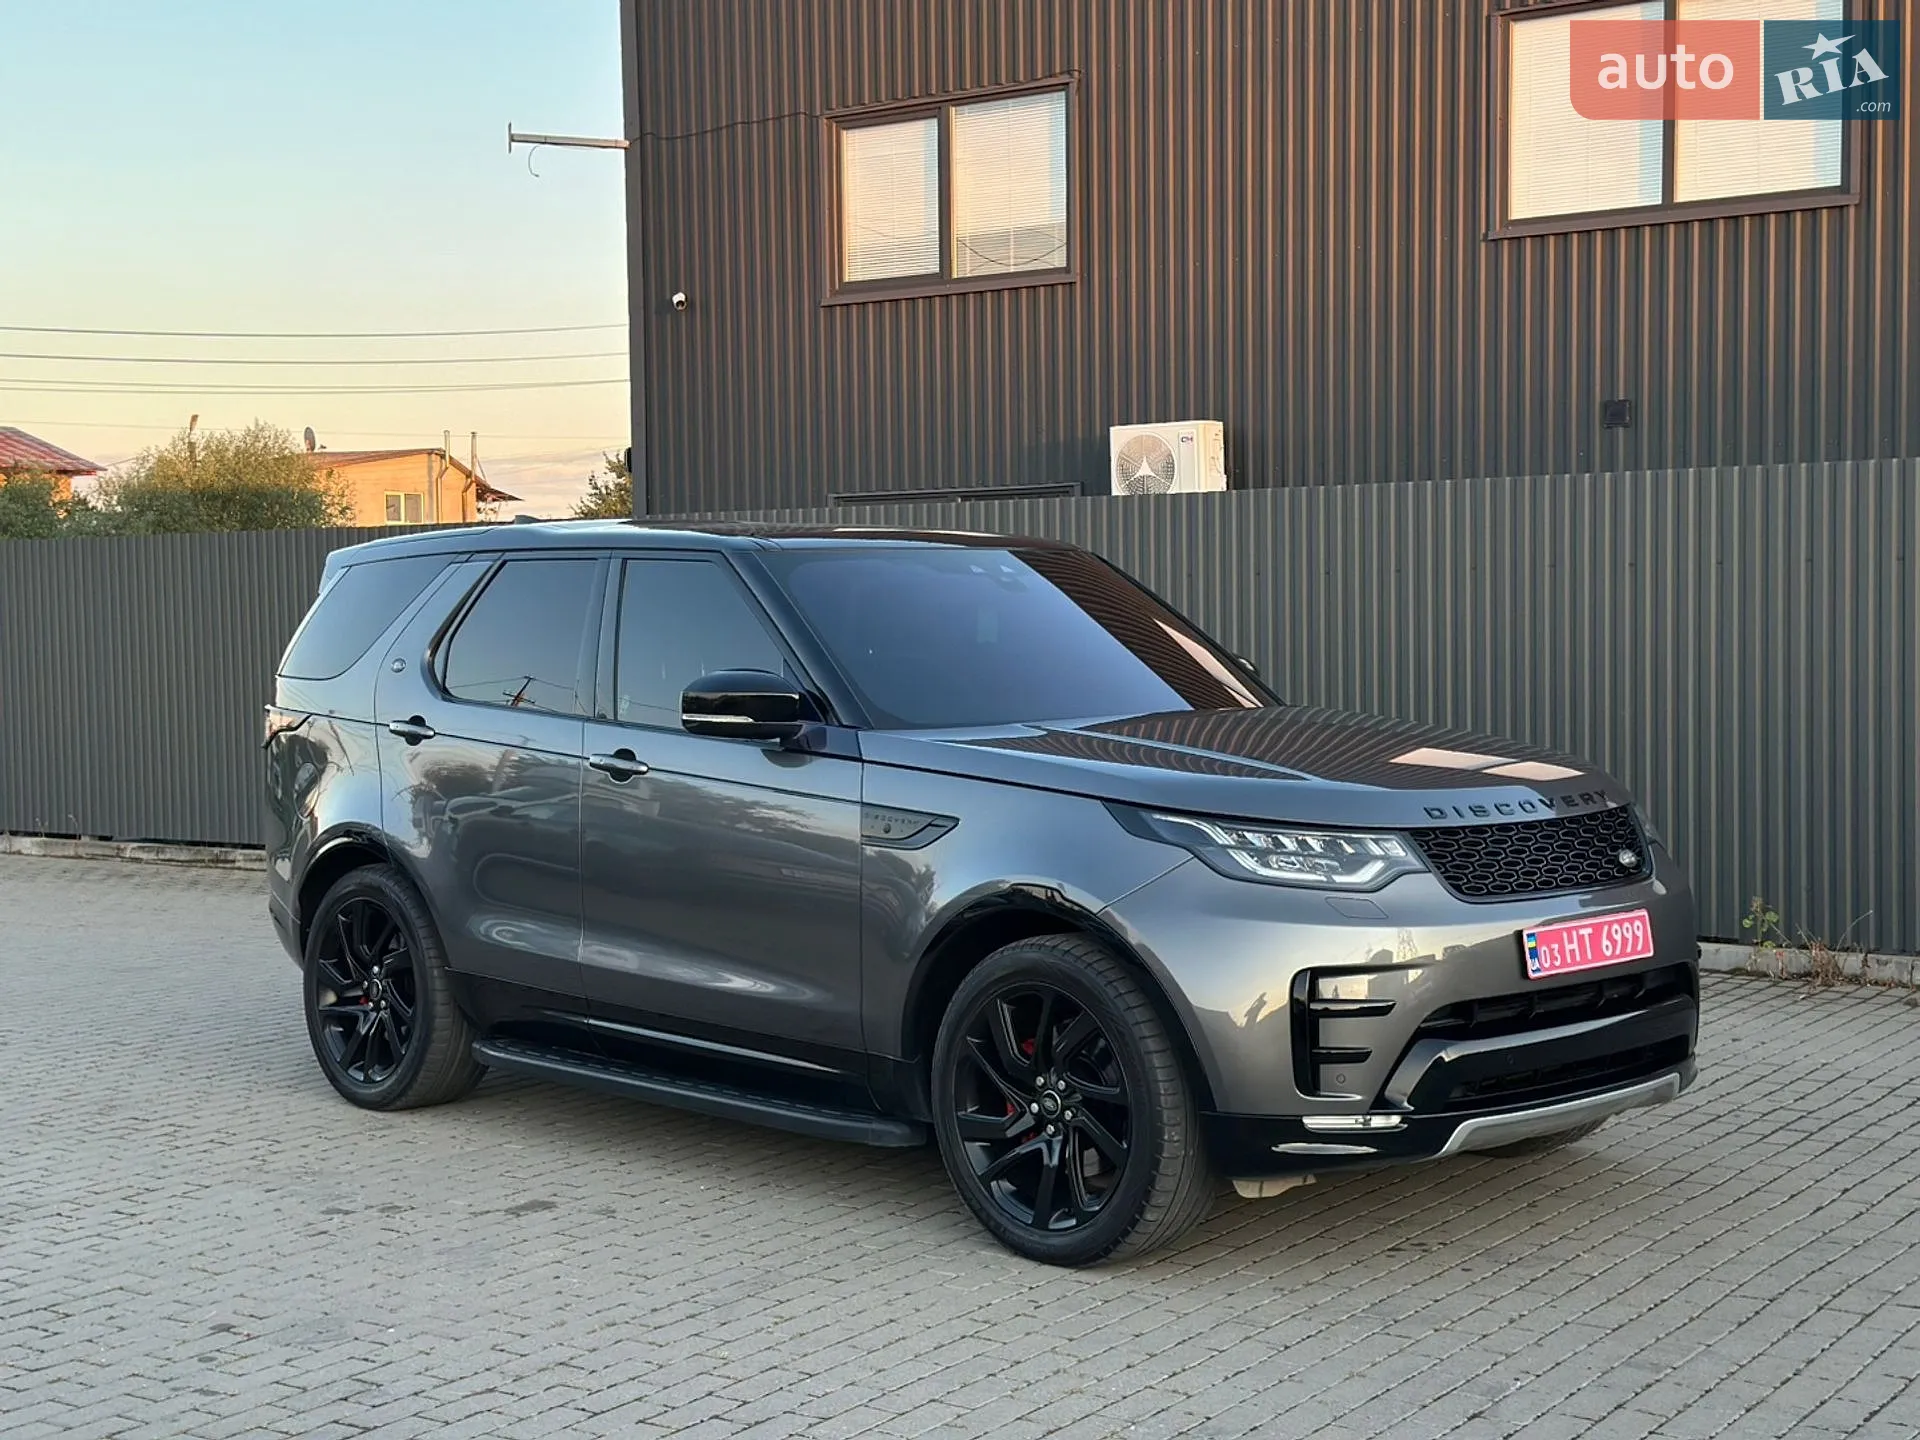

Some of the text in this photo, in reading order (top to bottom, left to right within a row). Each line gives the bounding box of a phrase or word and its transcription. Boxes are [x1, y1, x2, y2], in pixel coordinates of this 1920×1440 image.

[1423, 789, 1607, 820] DISCOVERY
[1541, 920, 1643, 968] 03 HT 6999
